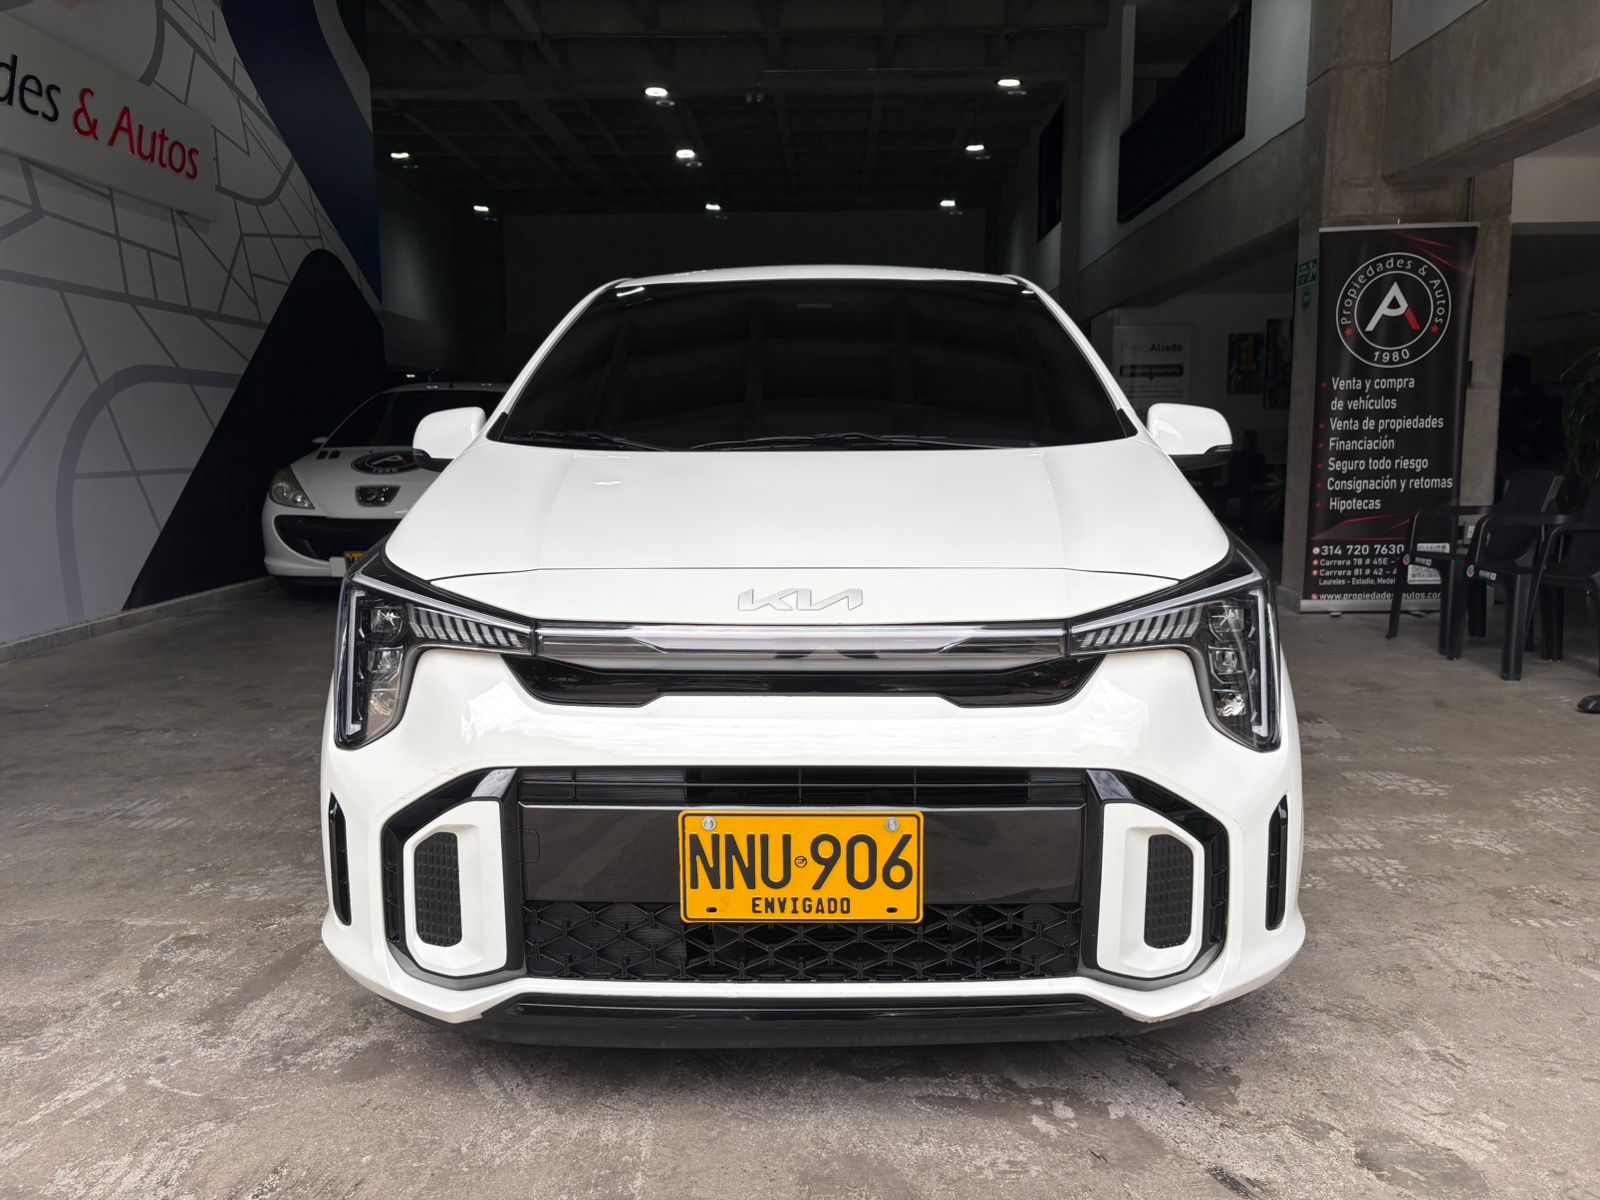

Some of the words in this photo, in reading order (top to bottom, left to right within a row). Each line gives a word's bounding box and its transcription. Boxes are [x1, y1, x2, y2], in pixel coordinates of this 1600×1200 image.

[73, 87, 99, 144] &
[107, 105, 199, 180] Autos
[1340, 257, 1413, 325] Propiedades
[1418, 264, 1429, 277] &
[1429, 278, 1446, 324] Autos
[1373, 348, 1410, 363] 1980
[1331, 376, 1362, 391] Venta
[1364, 378, 1372, 393] y
[1374, 377, 1415, 393] compra
[1330, 397, 1344, 411] de
[1347, 394, 1397, 410] vehículos
[1329, 417, 1359, 431] Venta
[1362, 416, 1375, 430] de
[1378, 415, 1444, 433] propiedades
[1329, 434, 1395, 451] Financiación
[1328, 457, 1365, 474] Seguro
[1368, 456, 1392, 470] todo
[1394, 456, 1429, 473] riesgo
[1327, 474, 1397, 494] Consignación
[1400, 479, 1407, 493] y
[1409, 477, 1453, 489] retomas
[1329, 497, 1381, 514] Hipotecas
[1321, 545, 1342, 556] 314
[1346, 544, 1369, 555] 720
[1373, 544, 1405, 555] 7630
[1320, 558, 1351, 567] Carrera
[1353, 557, 1363, 566] 78
[1364, 557, 1372, 566] #
[1319, 568, 1351, 577] Carrera
[1364, 568, 1372, 576] #
[1372, 567, 1384, 576] 42
[1318, 578, 1346, 586] Laureles
[1376, 577, 1396, 585] Medel
[737, 588, 863, 611] KIA
[689, 833, 792, 890] NNU
[810, 833, 913, 891] 906
[751, 896, 851, 914] ENVIGADO
